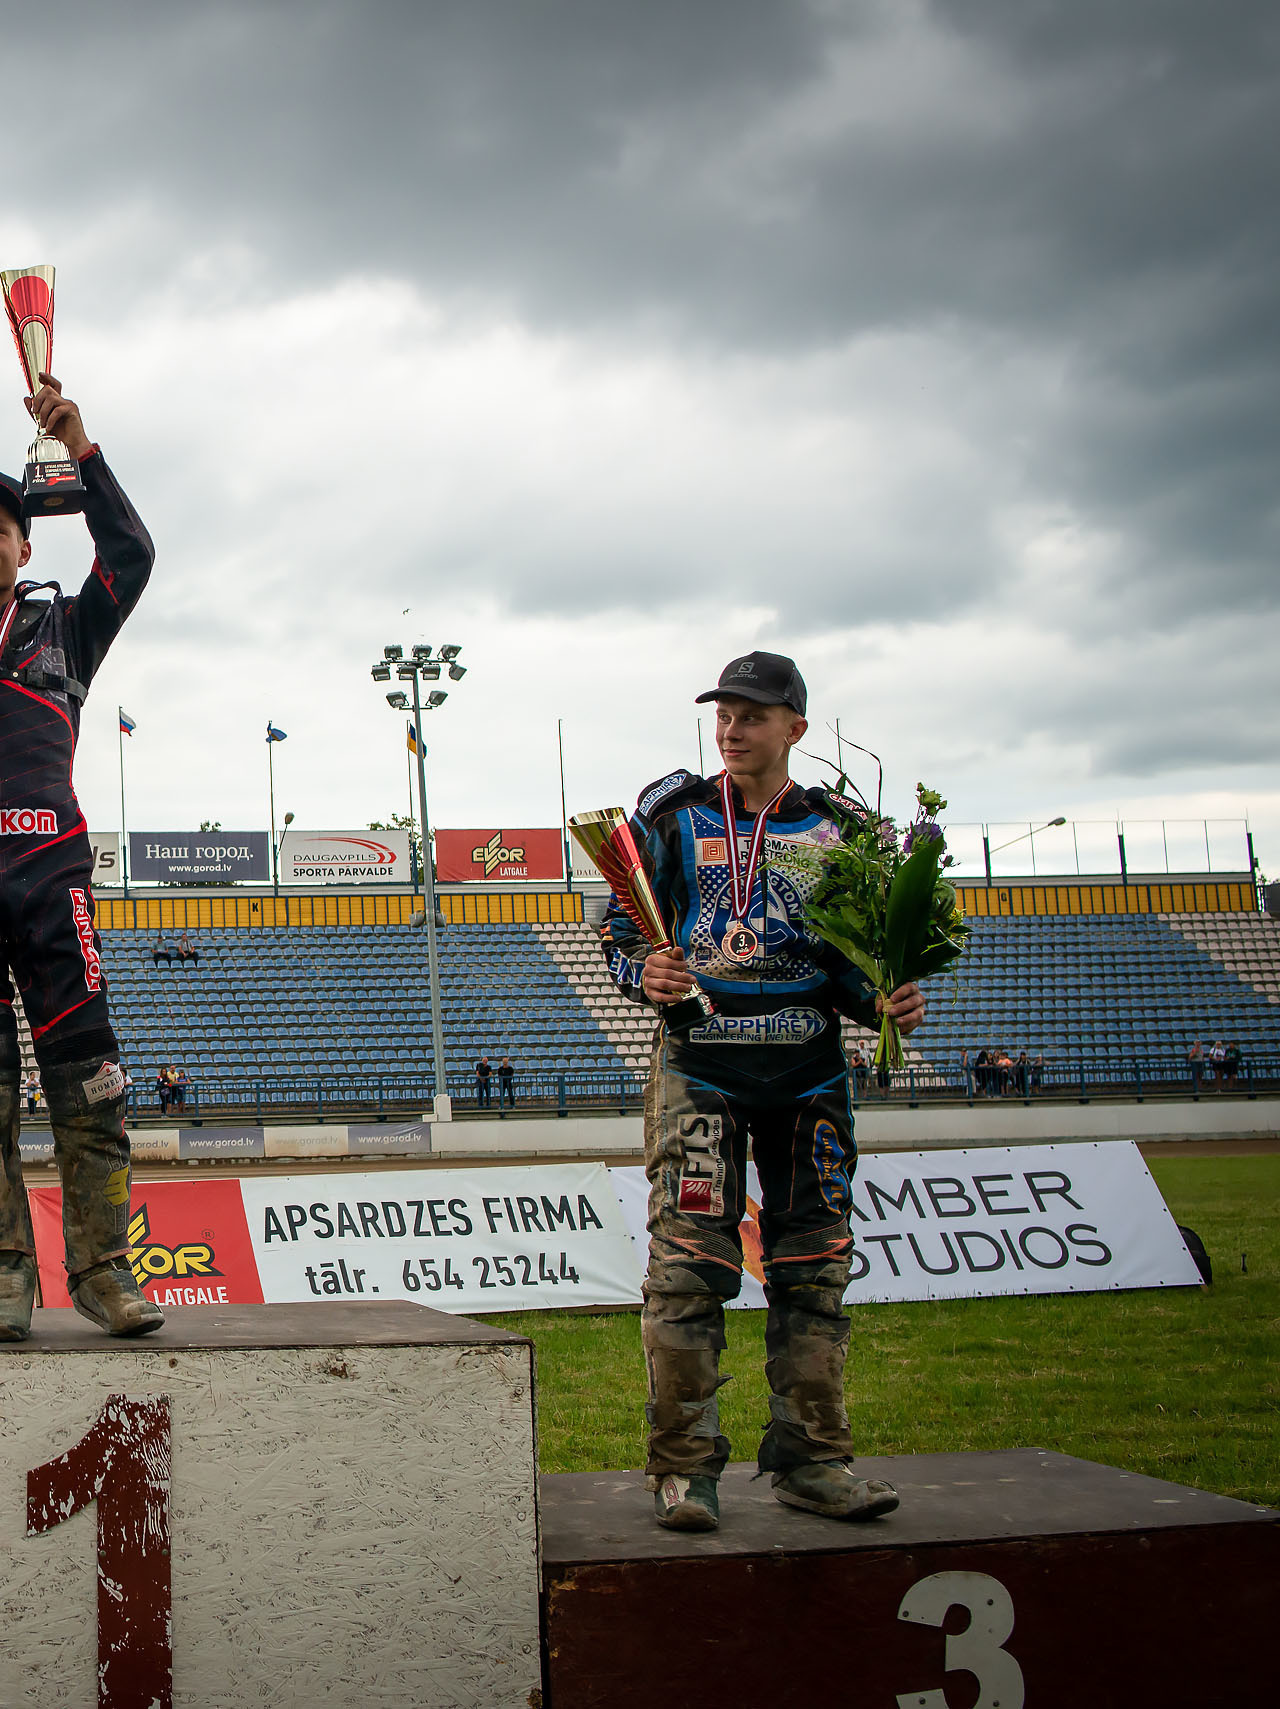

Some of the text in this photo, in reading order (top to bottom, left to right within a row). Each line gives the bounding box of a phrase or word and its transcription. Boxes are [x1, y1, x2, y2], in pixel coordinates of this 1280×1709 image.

[145, 844, 254, 862] Наш город.
[744, 838, 798, 855] TOMAS
[293, 853, 377, 862] DAUGAVPILS
[168, 864, 232, 873] www.gorod.lv
[293, 865, 394, 877] SPORTA PĀRVALDE
[500, 866, 528, 876] LATGALE
[71, 890, 101, 991] PRINTSOL
[691, 1033, 762, 1042] ENGINEERING
[189, 1137, 255, 1150] www.gorod.lv
[358, 1133, 422, 1145] www.gorod.lv
[264, 1194, 604, 1243] APSARDZES FIRMA
[304, 1251, 580, 1296] tālr. 654 25244
[153, 1286, 229, 1306] LATGALE
[26, 1393, 172, 1709] 1
[896, 1571, 1025, 1709] 3
